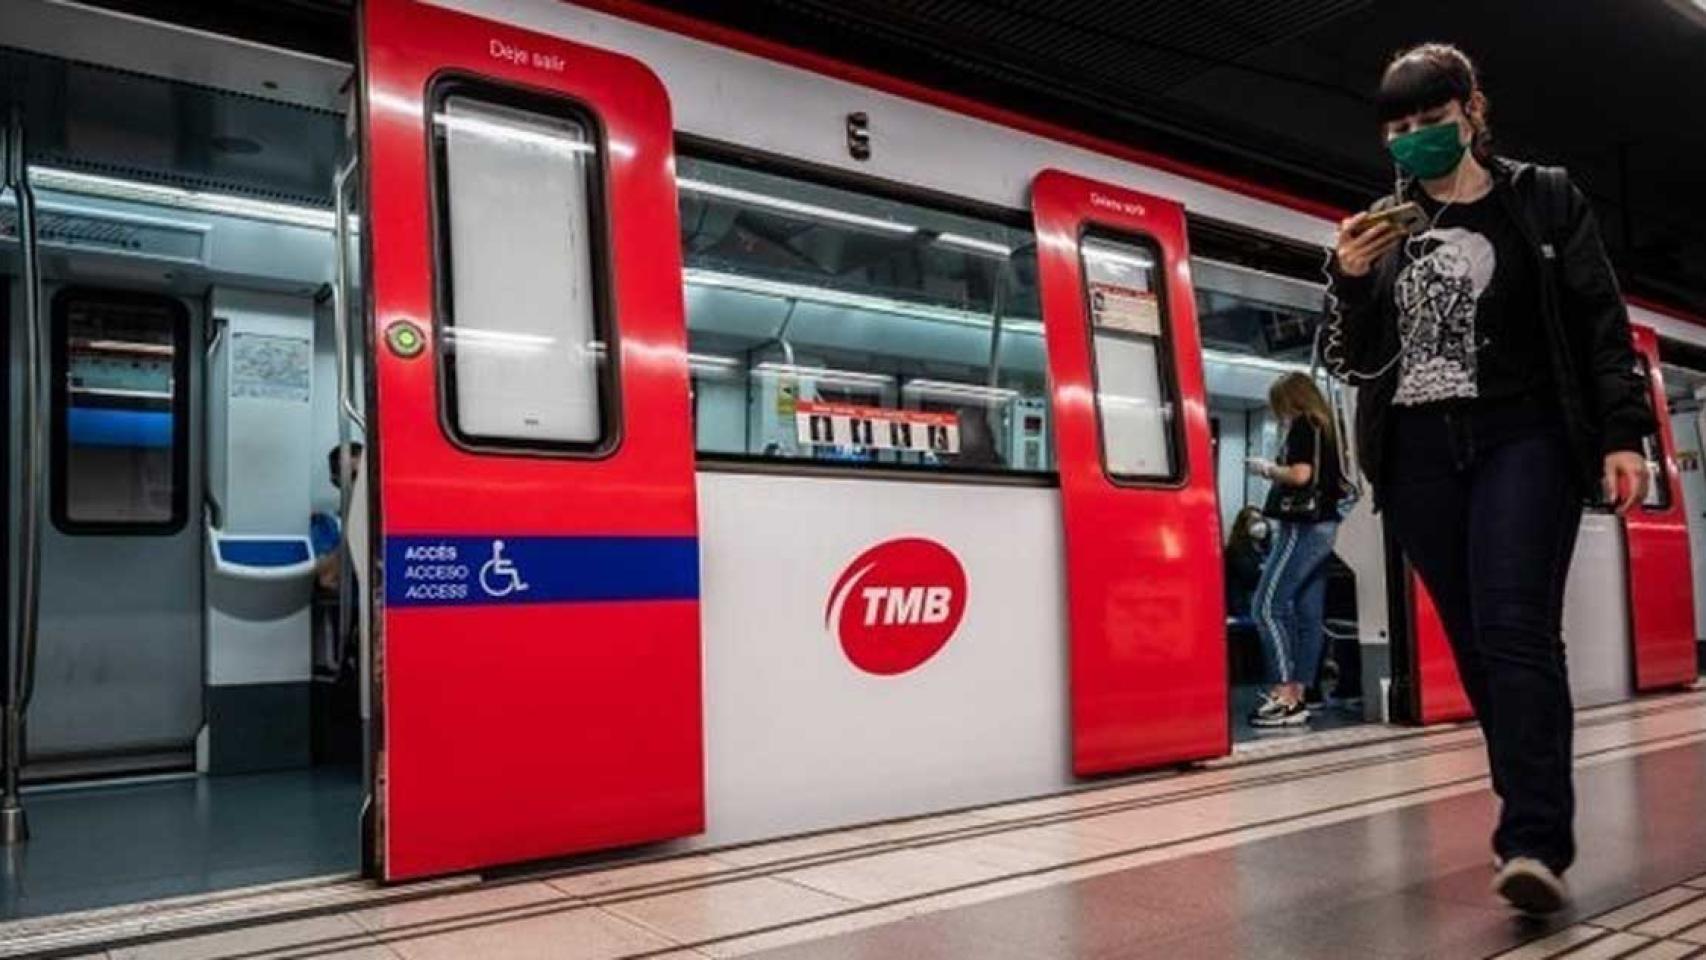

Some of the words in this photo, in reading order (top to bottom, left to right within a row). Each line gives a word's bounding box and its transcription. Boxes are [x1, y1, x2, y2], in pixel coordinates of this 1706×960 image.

[404, 564, 469, 580] ACCESO
[404, 583, 468, 600] ACCESS
[862, 586, 952, 626] TMB
